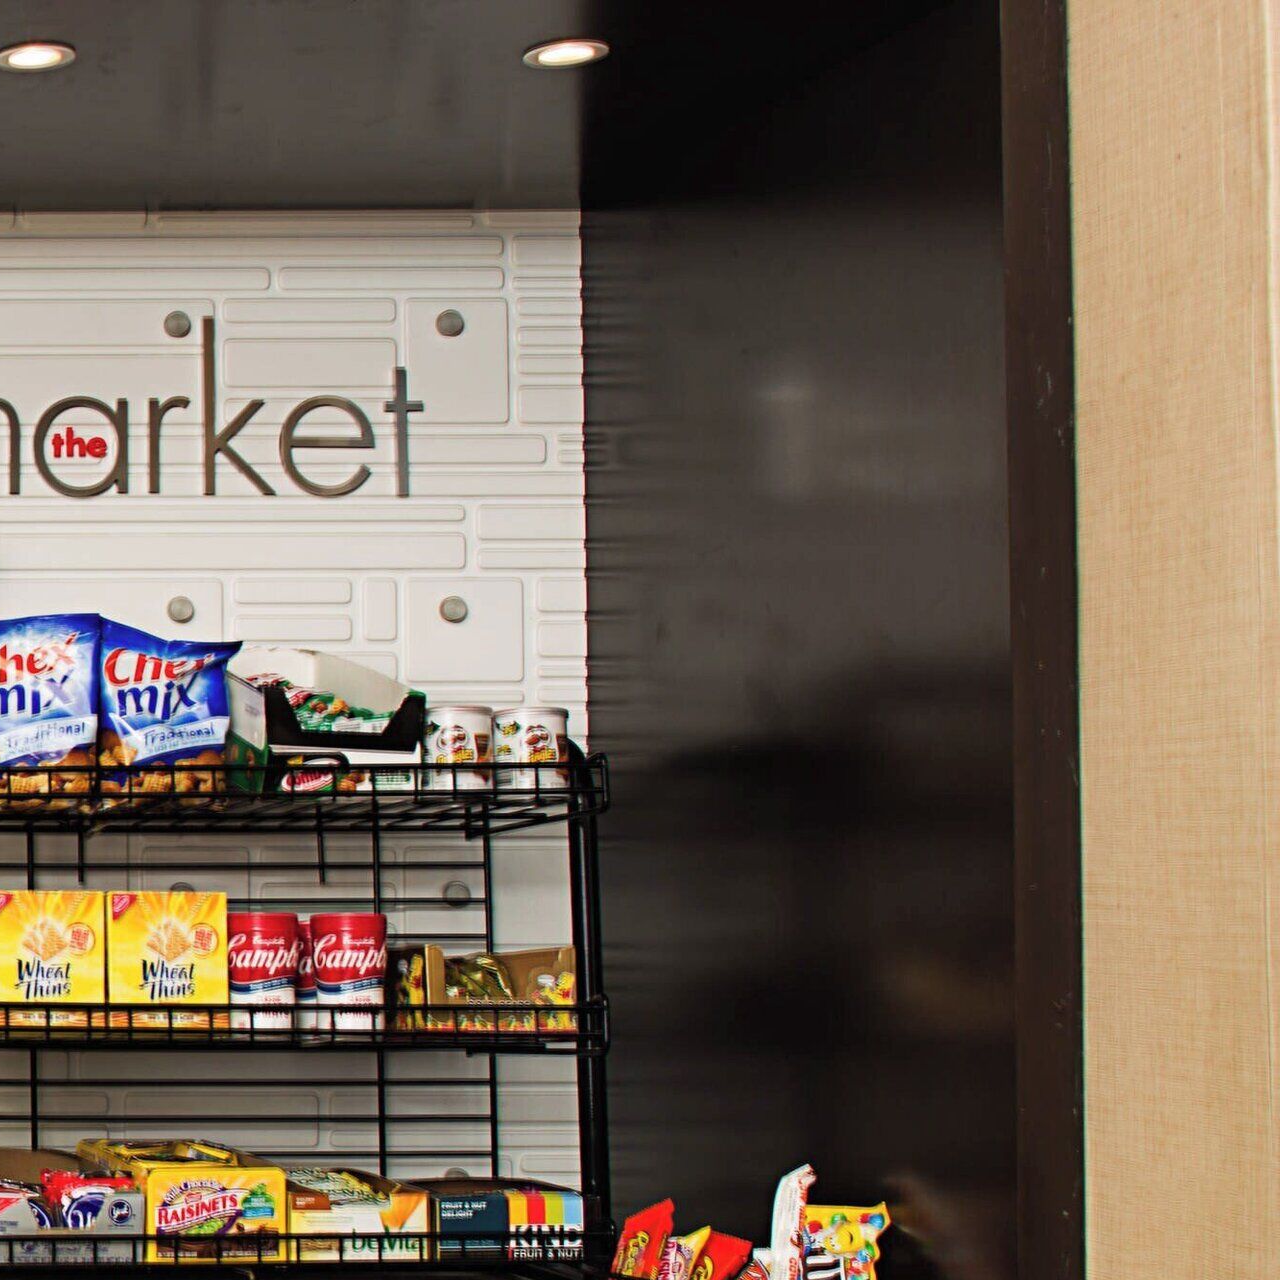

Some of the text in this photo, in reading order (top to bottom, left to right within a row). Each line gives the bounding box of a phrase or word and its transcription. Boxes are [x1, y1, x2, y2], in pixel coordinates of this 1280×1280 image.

[51, 427, 108, 460] the
[116, 672, 200, 721] mix
[17, 957, 71, 982] Wheat
[141, 957, 196, 982] Wheat
[14, 979, 72, 1001] Thins
[139, 979, 196, 1001] Thins
[157, 1192, 239, 1226] RAISINETS
